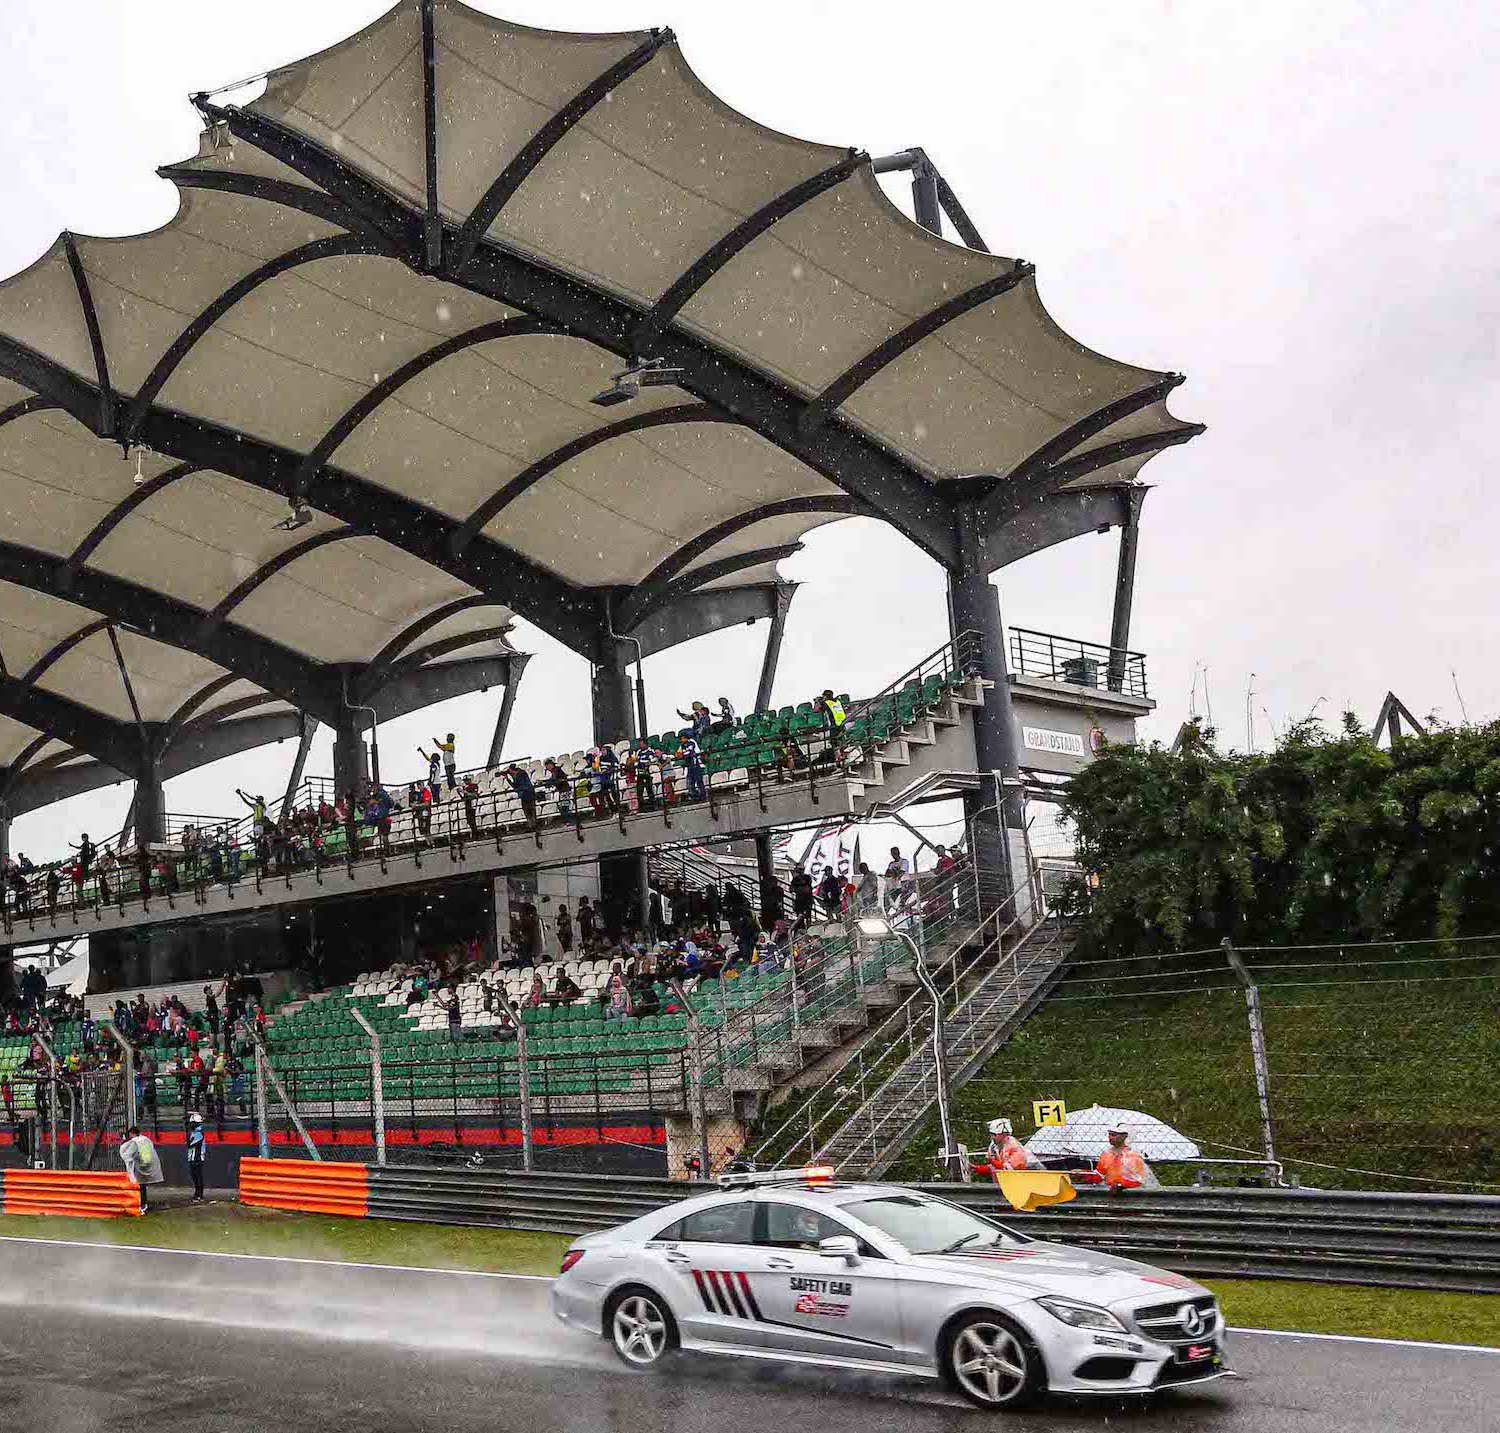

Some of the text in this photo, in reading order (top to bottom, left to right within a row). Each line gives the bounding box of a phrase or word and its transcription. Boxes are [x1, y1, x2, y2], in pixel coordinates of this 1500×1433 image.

[1028, 731, 1081, 752] GRANDSTAND
[1039, 1104, 1062, 1123] F1
[789, 1277, 853, 1296] SAFETY CAR
